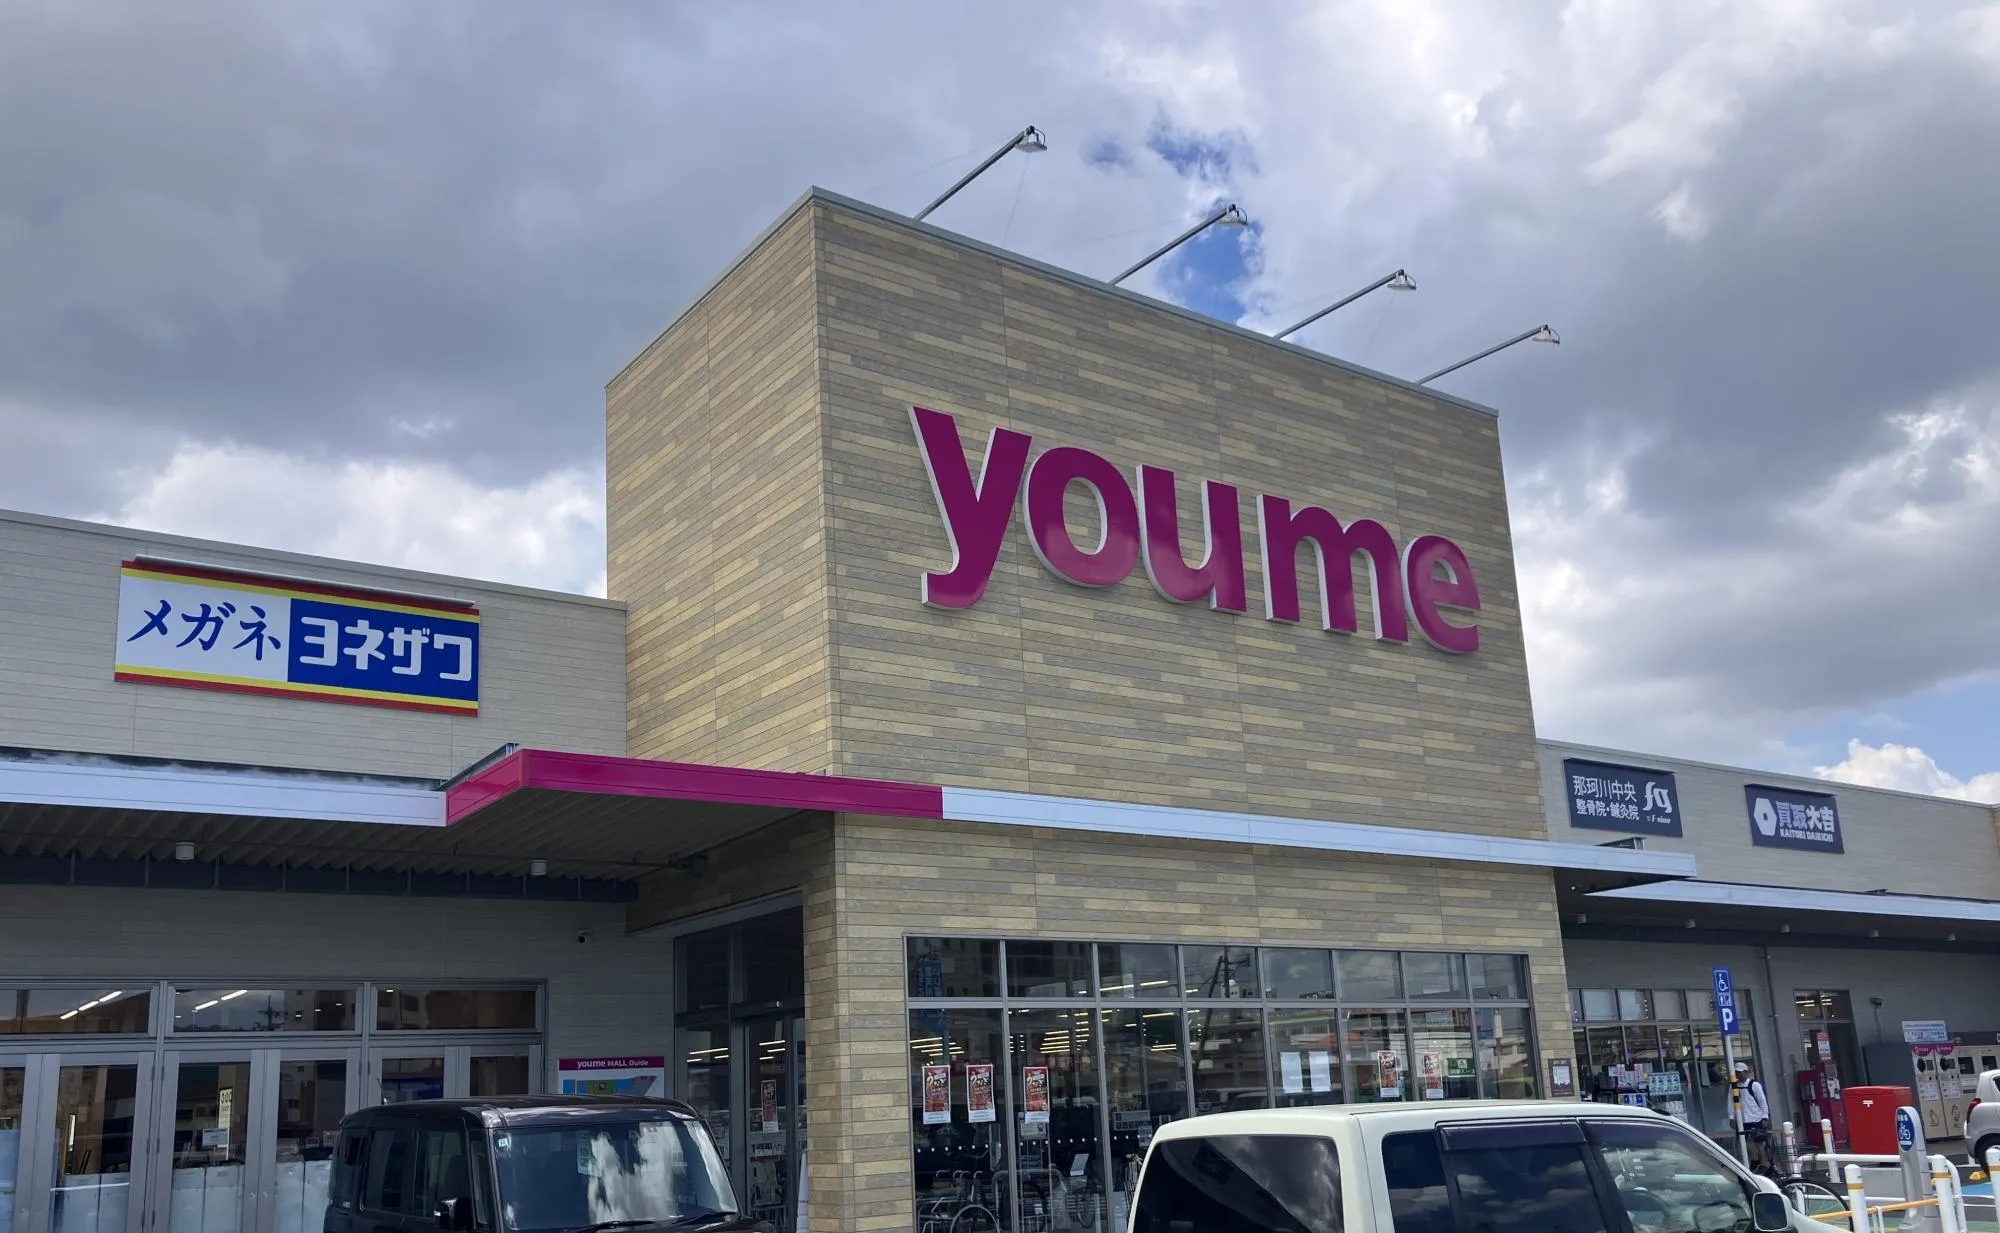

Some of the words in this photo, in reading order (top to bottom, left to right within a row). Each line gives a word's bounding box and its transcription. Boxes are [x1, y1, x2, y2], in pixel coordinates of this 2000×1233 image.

[912, 406, 1481, 654] youme
[1572, 775, 1637, 802] 那珂川中央
[1780, 828, 1806, 840] KAITORI
[1722, 1008, 1733, 1031] P
[577, 1060, 606, 1069] youme
[607, 1060, 628, 1068] MALL
[629, 1059, 649, 1067] Guide
